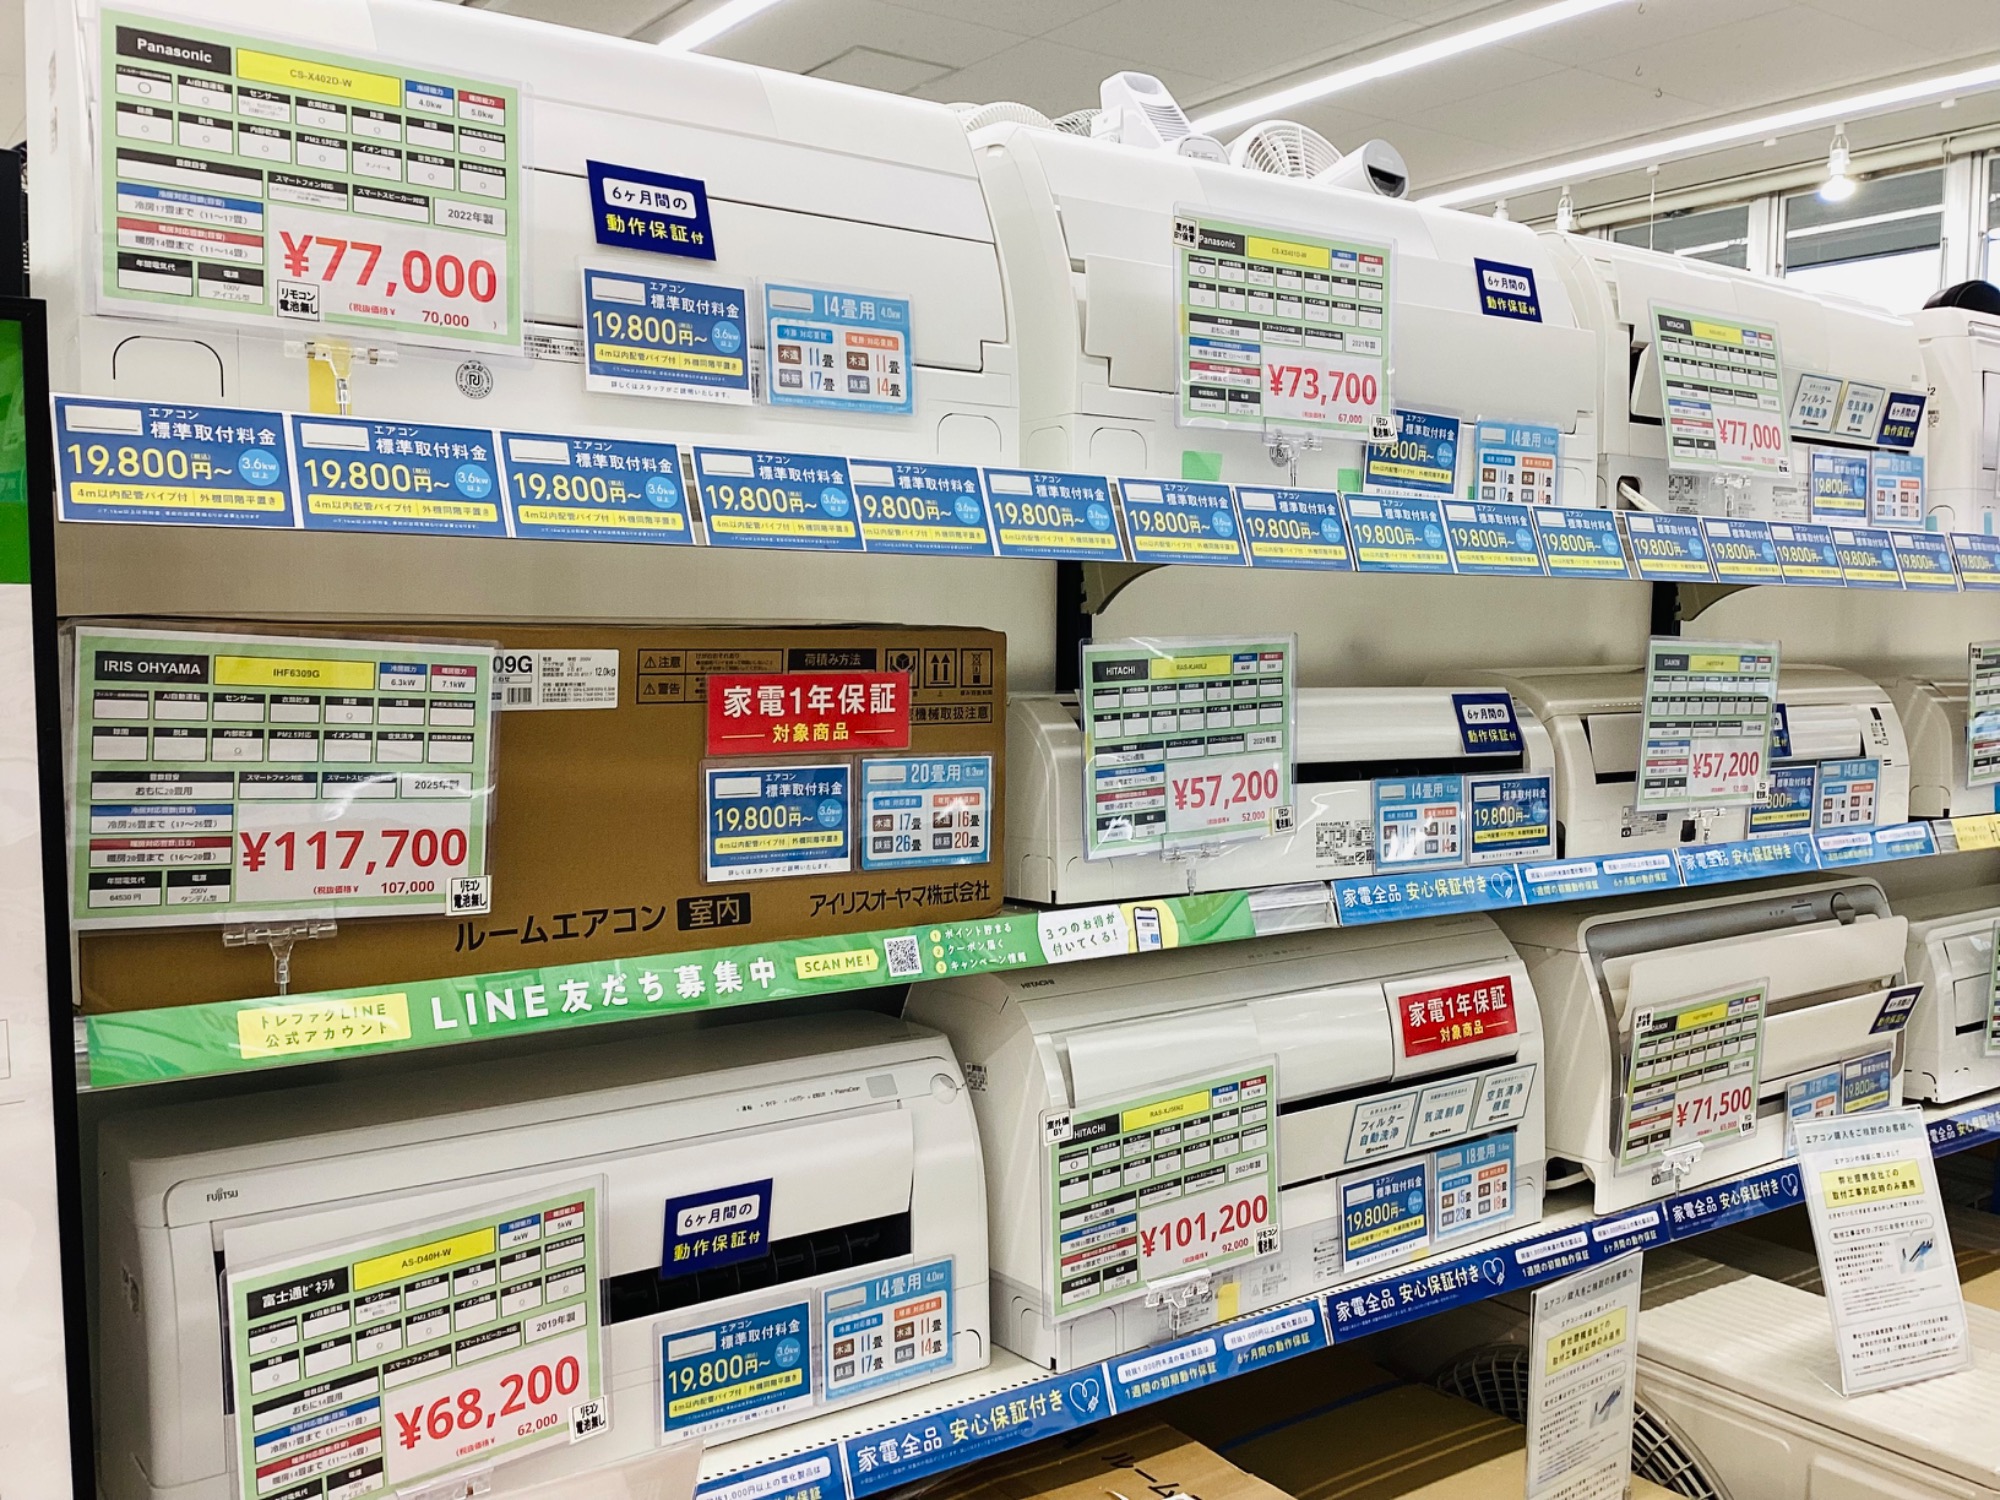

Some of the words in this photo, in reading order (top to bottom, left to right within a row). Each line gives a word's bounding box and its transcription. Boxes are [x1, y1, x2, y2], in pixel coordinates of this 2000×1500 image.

[137, 37, 212, 64] Panasonic
[289, 68, 352, 88] CS-X402D-W
[250, 90, 279, 100] センサー
[275, 174, 334, 190] スマートフォン対応
[357, 188, 425, 205] スマートスピーカー対応
[611, 186, 688, 211] 6ヶ月間の
[447, 208, 494, 225] 2022年製
[605, 213, 705, 246] 動作保証付
[1199, 234, 1236, 250] Panasonic
[279, 231, 498, 303] ¥77,000
[649, 281, 686, 294] エアコン
[1487, 274, 1527, 292] 6ヶ月間の
[281, 287, 315, 301] リモコン
[279, 299, 319, 315] 電池無し
[650, 294, 740, 319] 標準取付料金
[823, 294, 876, 321] 14畳用
[1485, 295, 1537, 317] 動作保証付
[421, 310, 470, 328] 70,000
[598, 348, 676, 365] 4m以内配管パイプ付
[780, 349, 799, 361] 木造
[849, 355, 867, 367] 木造
[1267, 363, 1377, 406] ¥73,700
[148, 407, 200, 421] エアコン
[1337, 413, 1363, 425] 67,000
[150, 421, 277, 447] 標準取付料金
[374, 425, 419, 437] エアコン
[1405, 426, 1455, 441] 標準取付料金
[1716, 418, 1782, 451] ¥77,000
[376, 438, 488, 462] 標準取付料金
[572, 440, 613, 452] エアコン
[67, 444, 233, 481] 19,800円～
[574, 453, 674, 475] 標準取付料金
[757, 454, 791, 465] エアコン
[303, 459, 450, 493] 19,800円～
[758, 465, 844, 485] 標準取付料金
[896, 465, 927, 474] エアコン
[513, 472, 642, 504] 19,800円～
[898, 476, 976, 494] 標準取付料金
[1035, 484, 1106, 502] 標準取付料金
[77, 488, 188, 503] 4m以内配管パイプ付
[1166, 493, 1229, 510] 標準取付料金
[313, 499, 412, 514] 4m以内配管パイプ付
[523, 508, 610, 524] 4m以内配管パイプ付
[1278, 500, 1337, 516] 標準取付料金
[1384, 508, 1438, 523] 標準取付料金
[715, 520, 790, 533] 4m以内配管パイプ付
[1478, 512, 1528, 527] 標準取付料金
[103, 660, 133, 673] IRIS
[137, 662, 201, 675] OHYAMA
[658, 655, 681, 669] 注意
[803, 652, 862, 667] 荷積み方法
[272, 668, 321, 678] IHF6309G
[1106, 665, 1136, 676] HITACHI
[225, 694, 255, 702] センサー
[657, 682, 681, 696] 警告
[723, 683, 896, 718] 家電1年保証
[1467, 707, 1505, 720] 6ヶ月間の
[772, 722, 850, 744] 対象商品
[1467, 729, 1517, 744] 動作保証付
[910, 763, 962, 783] 20畳用
[1692, 750, 1760, 782] ¥57,200
[246, 773, 304, 781] スマートフォン対応
[765, 772, 797, 782] エアコン
[765, 782, 843, 798] 標準取付料金
[1172, 768, 1278, 811] ¥57,200
[1411, 782, 1443, 799] 14畳用
[875, 817, 891, 829] 木造
[1241, 810, 1266, 822] 52,000
[239, 828, 468, 875] ¥117,700
[718, 838, 786, 850] 4m以内配管パイプ付
[380, 880, 435, 895] 107,000
[459, 880, 480, 893] リモコン
[1342, 883, 1402, 908] 家電全品
[1406, 874, 1487, 902] 安心保証付き
[453, 893, 487, 909] 電池無し
[810, 879, 991, 918] アイリスオーヤマ株式会社
[454, 904, 667, 953] ルームエアコン
[689, 895, 741, 927] 室内
[943, 921, 1013, 941] ポイント貯まる
[1044, 912, 1115, 941] 3つのお得が
[946, 938, 1005, 956] クーポン届く
[804, 958, 839, 974] SCAN
[842, 954, 871, 971] ME!
[949, 951, 1028, 972] キャンペーン情報
[430, 983, 550, 1031] LINE
[557, 957, 777, 1014] 友だち募集中
[260, 1002, 388, 1028] トレファクLINE
[1408, 984, 1508, 1029] 家電1年保証
[264, 1020, 391, 1049] 公式アカウント
[1439, 1019, 1485, 1043] 対象商品
[1486, 1083, 1524, 1102] 空気清浄
[1423, 1104, 1466, 1124] 気流制御
[1491, 1098, 1511, 1113] 機能
[1675, 1086, 1753, 1128] ¥71,500
[1053, 1127, 1064, 1138] BY
[1074, 1123, 1106, 1140] HITACHI
[1360, 1115, 1405, 1132] フィルター
[1359, 1127, 1400, 1147] 自動洗浄
[206, 1187, 239, 1202] FUJITSU
[1375, 1176, 1423, 1200] 標準取付料金
[1831, 1179, 1917, 1201] 取付工事対応時のみ適用
[1672, 1196, 1718, 1225] 家電全品
[1719, 1179, 1780, 1208] 安心保証付き
[684, 1202, 753, 1229] 6ヶ月間の
[1140, 1194, 1268, 1258] ¥101,200
[673, 1230, 761, 1263] 動作保証付
[1221, 1237, 1249, 1254] 92,000
[1603, 1229, 1658, 1254] 6ヶ月間の動作保証
[401, 1247, 452, 1269] AS-D40H-W
[1521, 1250, 1590, 1278] 1週間の初期動作保証
[874, 1273, 922, 1301] 14畳用
[1335, 1286, 1395, 1324] 家電全品
[1398, 1264, 1480, 1304] 安心保証付き
[536, 1311, 576, 1333] 2019年製
[719, 1319, 753, 1334] エアコン
[458, 1324, 518, 1350] スマートスピーカー対応
[720, 1318, 801, 1350] 標準取付料金
[1236, 1331, 1311, 1365] 6ヶ月間の動作保証
[388, 1349, 440, 1372] スマートフォン対応
[1124, 1361, 1218, 1399] 1週間の初期動作保証
[394, 1355, 580, 1450] ¥68,200
[672, 1387, 743, 1413] 4m以内配管パイプ付
[517, 1413, 558, 1437] 62,000
[575, 1417, 606, 1436] 電池無し
[856, 1425, 943, 1474] 家電全品
[949, 1387, 1065, 1446] 安心保証付き
